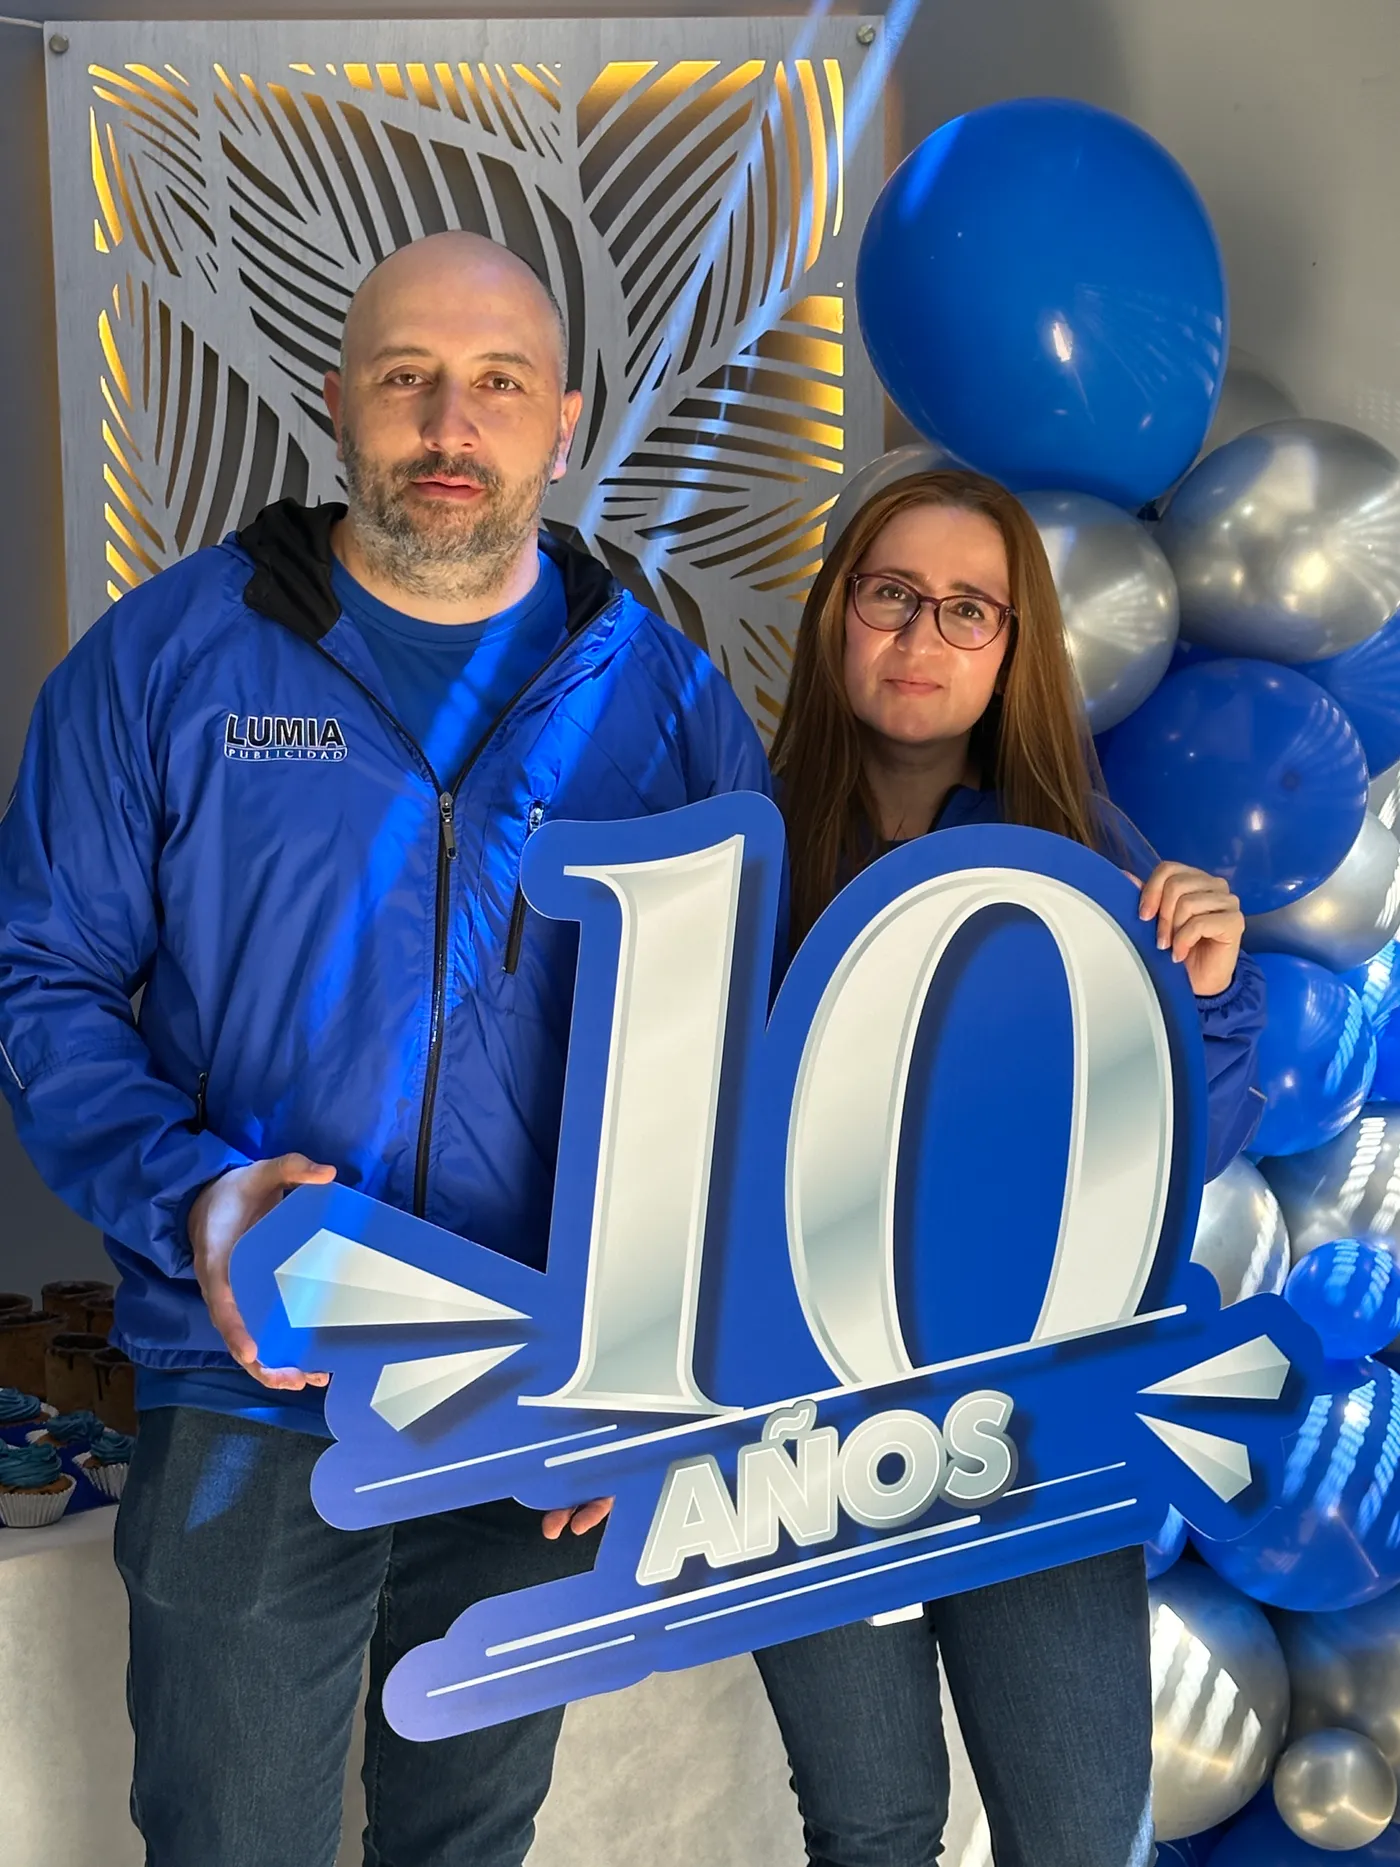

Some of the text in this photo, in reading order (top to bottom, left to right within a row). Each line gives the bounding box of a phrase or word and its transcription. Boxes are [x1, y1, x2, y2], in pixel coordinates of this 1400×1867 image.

[225, 714, 346, 748] LUMIA
[228, 749, 343, 760] PUBLICIDAD
[517, 833, 1174, 1415] 10
[636, 1389, 1018, 1587] AÑOS
